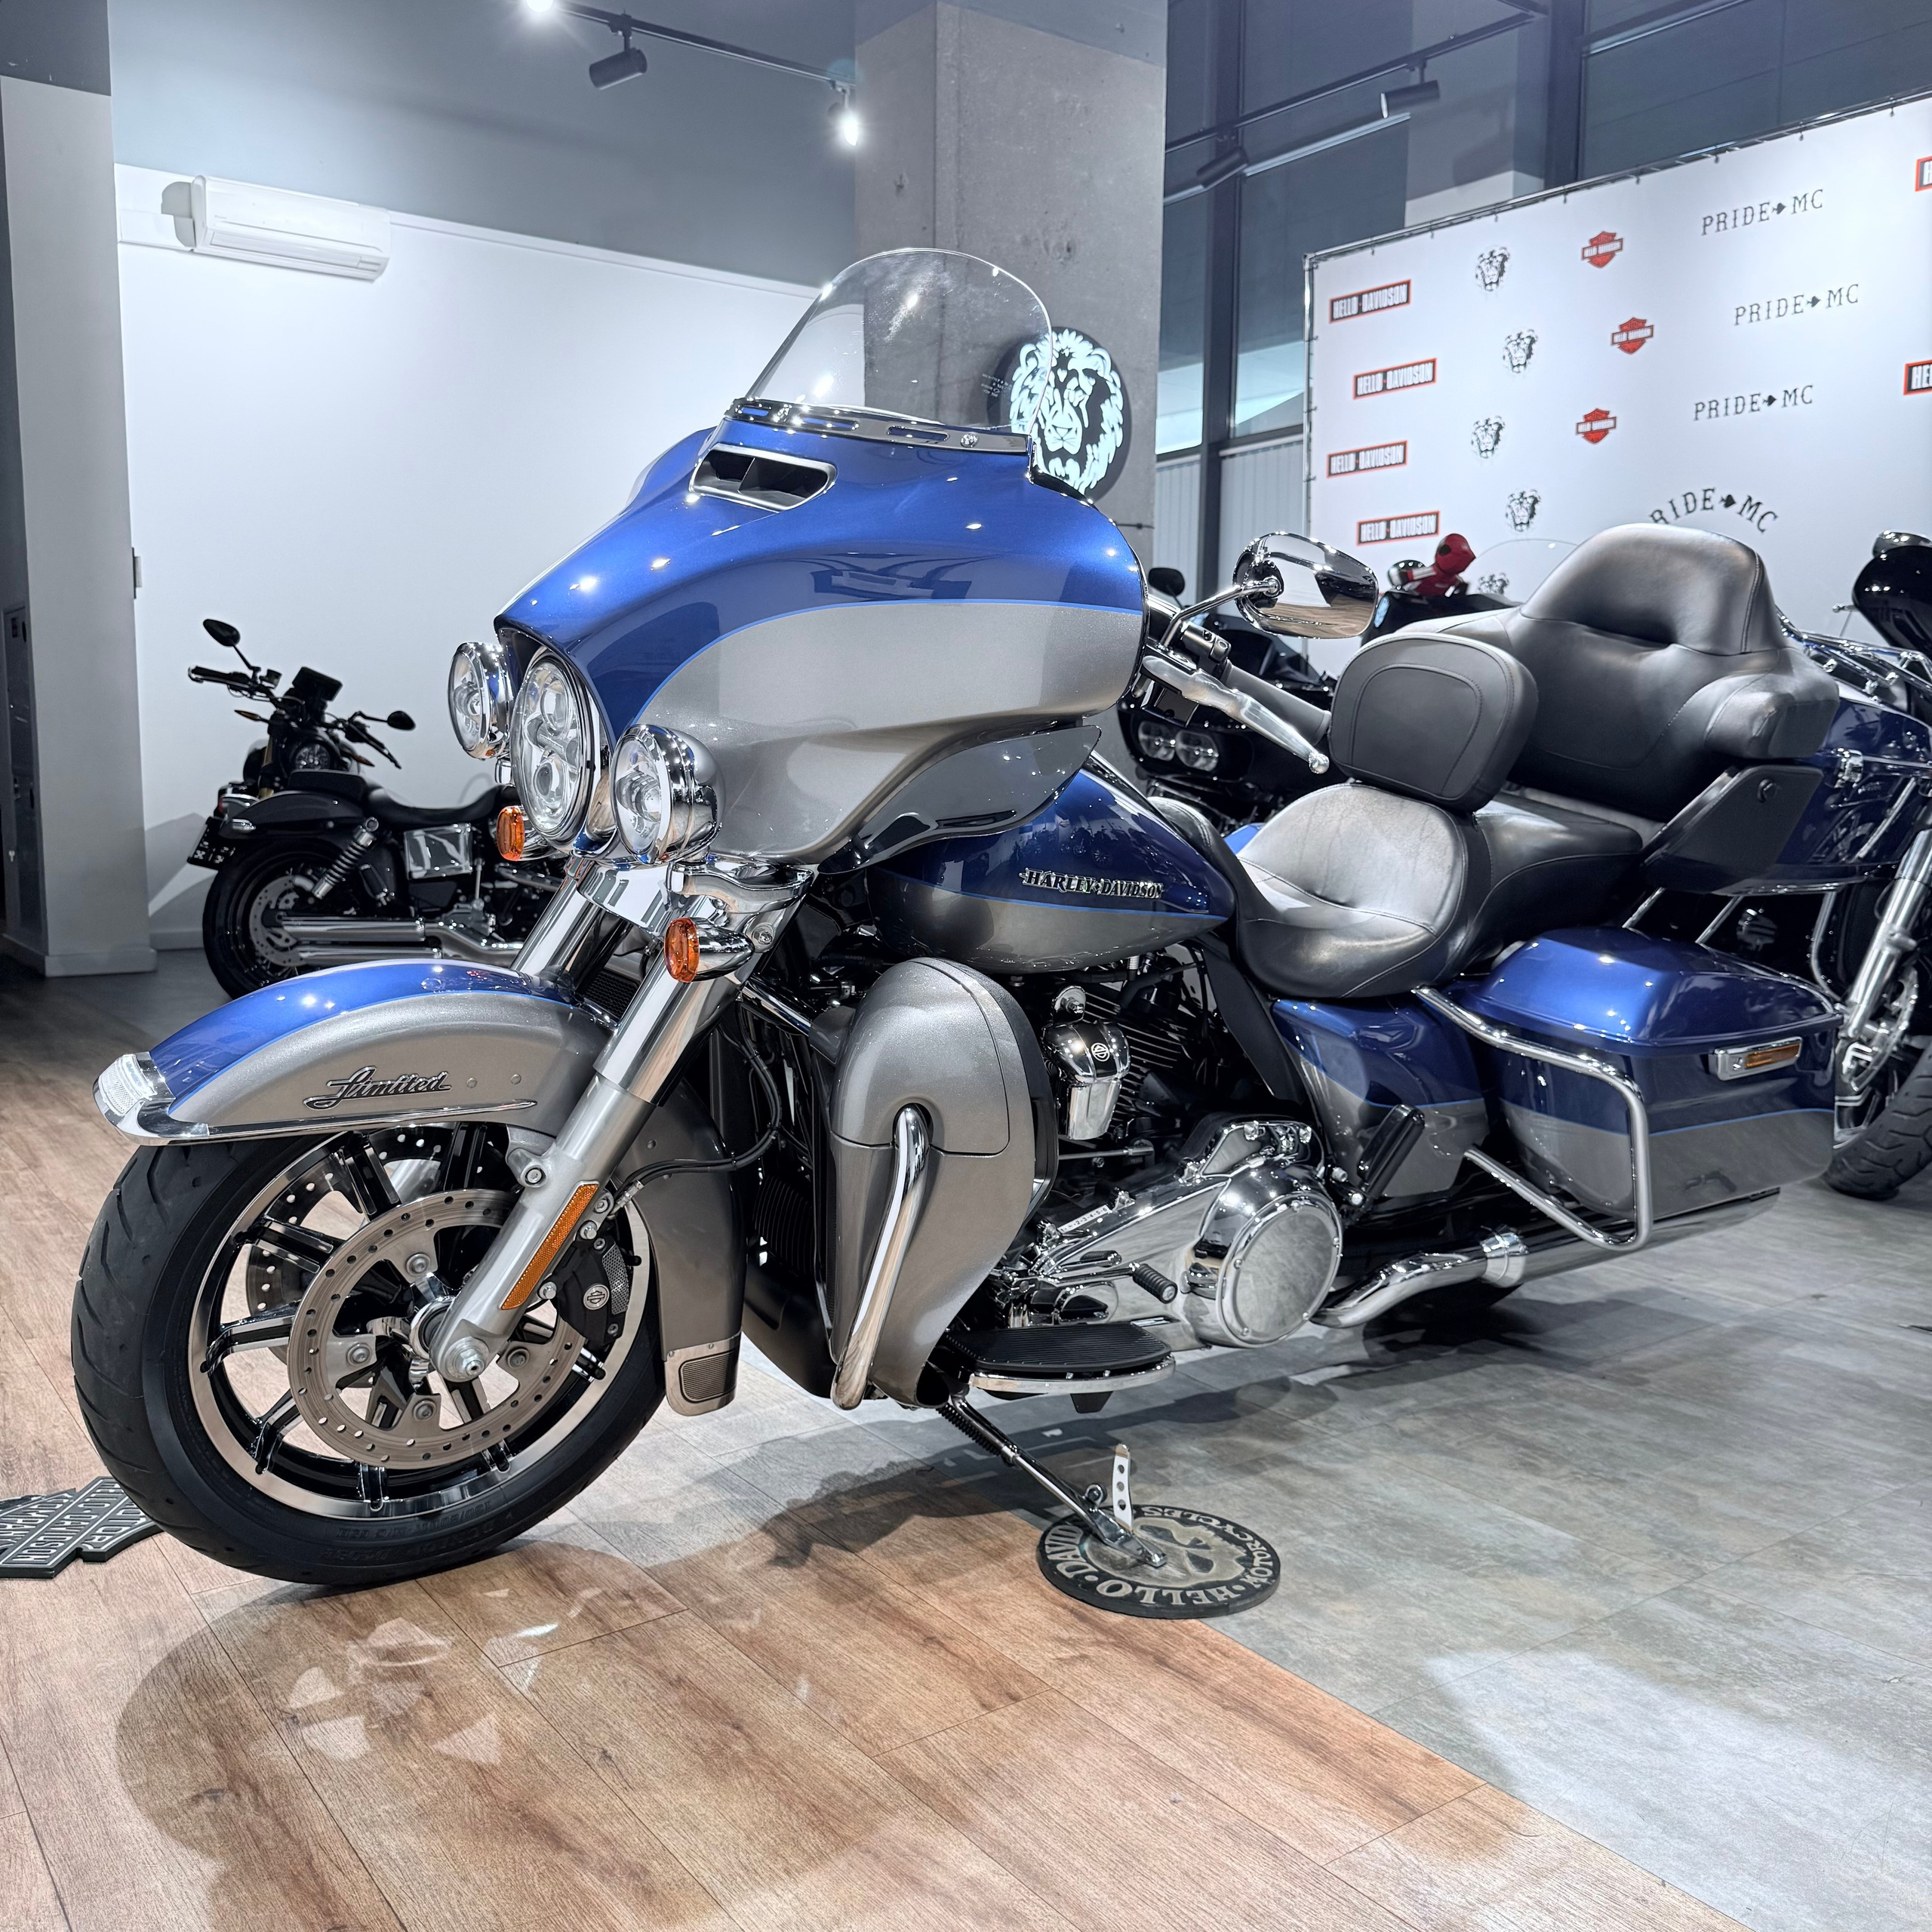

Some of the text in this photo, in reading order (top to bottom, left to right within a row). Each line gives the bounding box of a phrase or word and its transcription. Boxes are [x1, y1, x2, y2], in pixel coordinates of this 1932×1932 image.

[1701, 189, 1823, 236] PRIDE MC
[1734, 284, 1859, 326] PRIDE MC
[1694, 384, 1814, 421] PRIDE MC
[1648, 487, 1779, 534] RIDE MC
[303, 1066, 452, 1110] Limited
[12, 1514, 98, 1561] DAVIDSON
[84, 1502, 147, 1543] OTOR
[1143, 1506, 1273, 1585] MOTORCYCLES
[1096, 1579, 1242, 1605] HELLO
